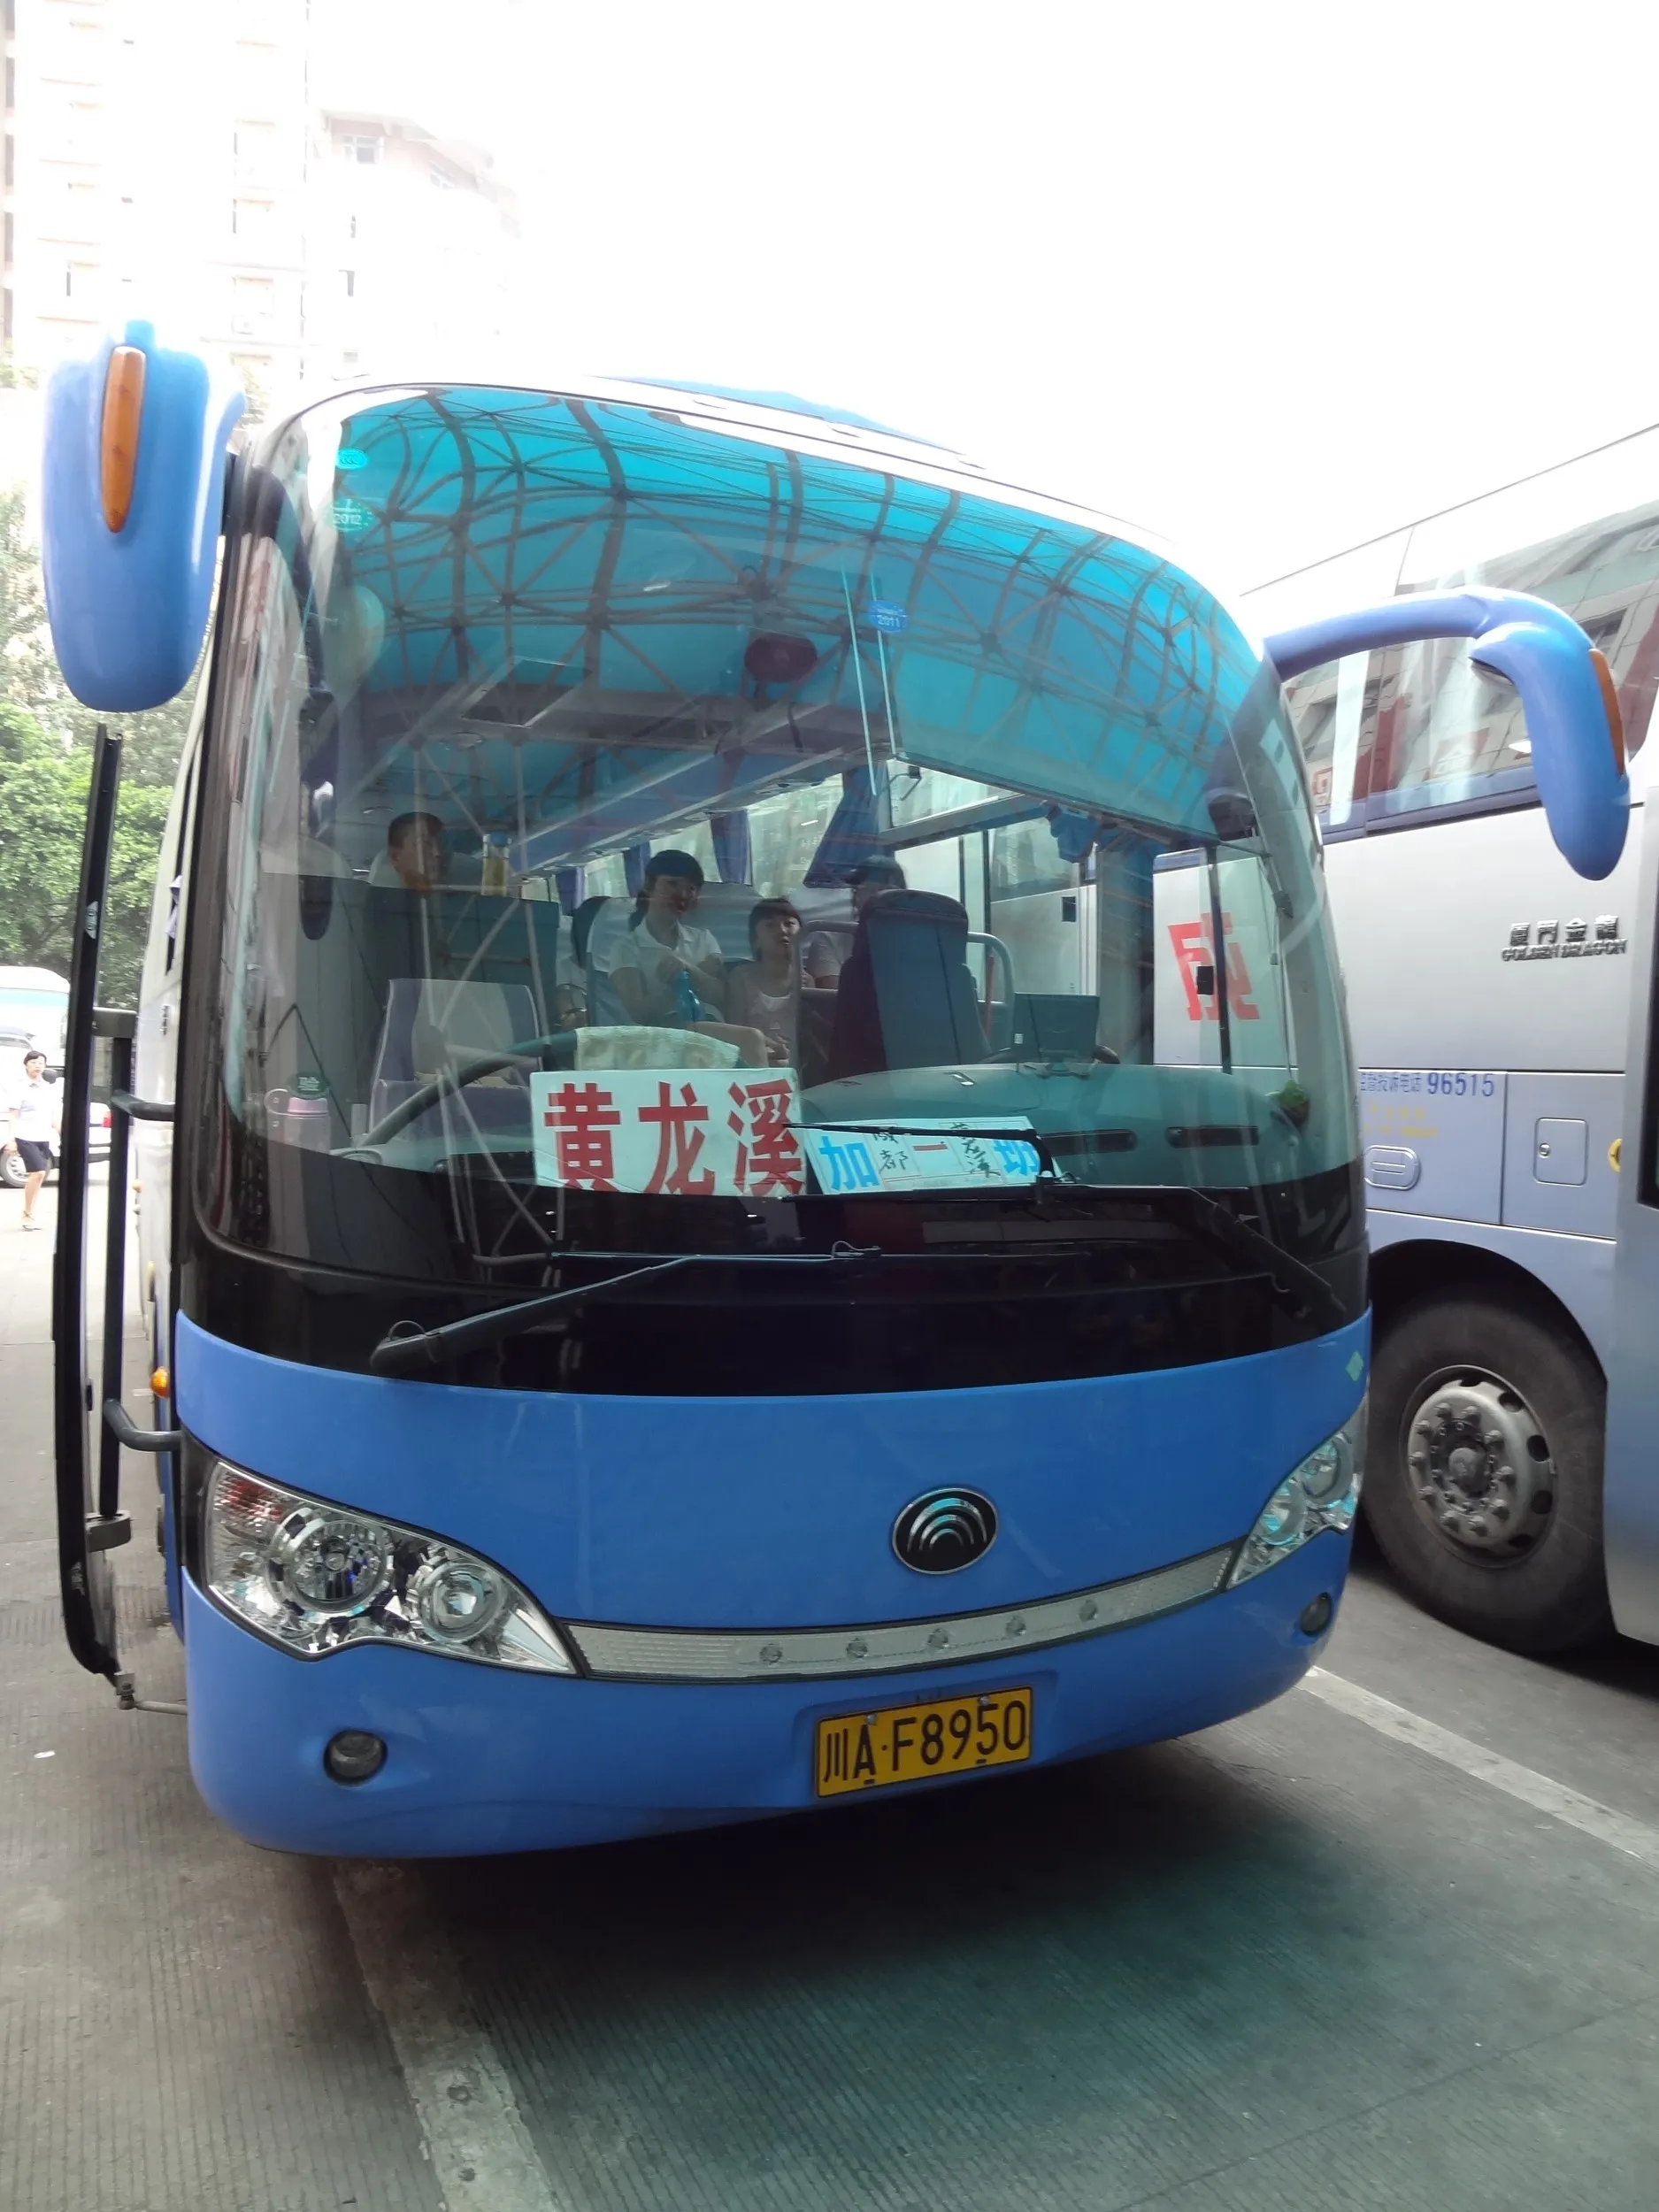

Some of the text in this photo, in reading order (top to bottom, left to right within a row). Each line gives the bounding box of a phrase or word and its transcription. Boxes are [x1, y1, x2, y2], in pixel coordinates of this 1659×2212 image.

[877, 614, 901, 628] 2011
[1427, 1071, 1494, 1097] 96515
[543, 1078, 805, 1194] 黄龙溪
[819, 1136, 879, 1191] 加
